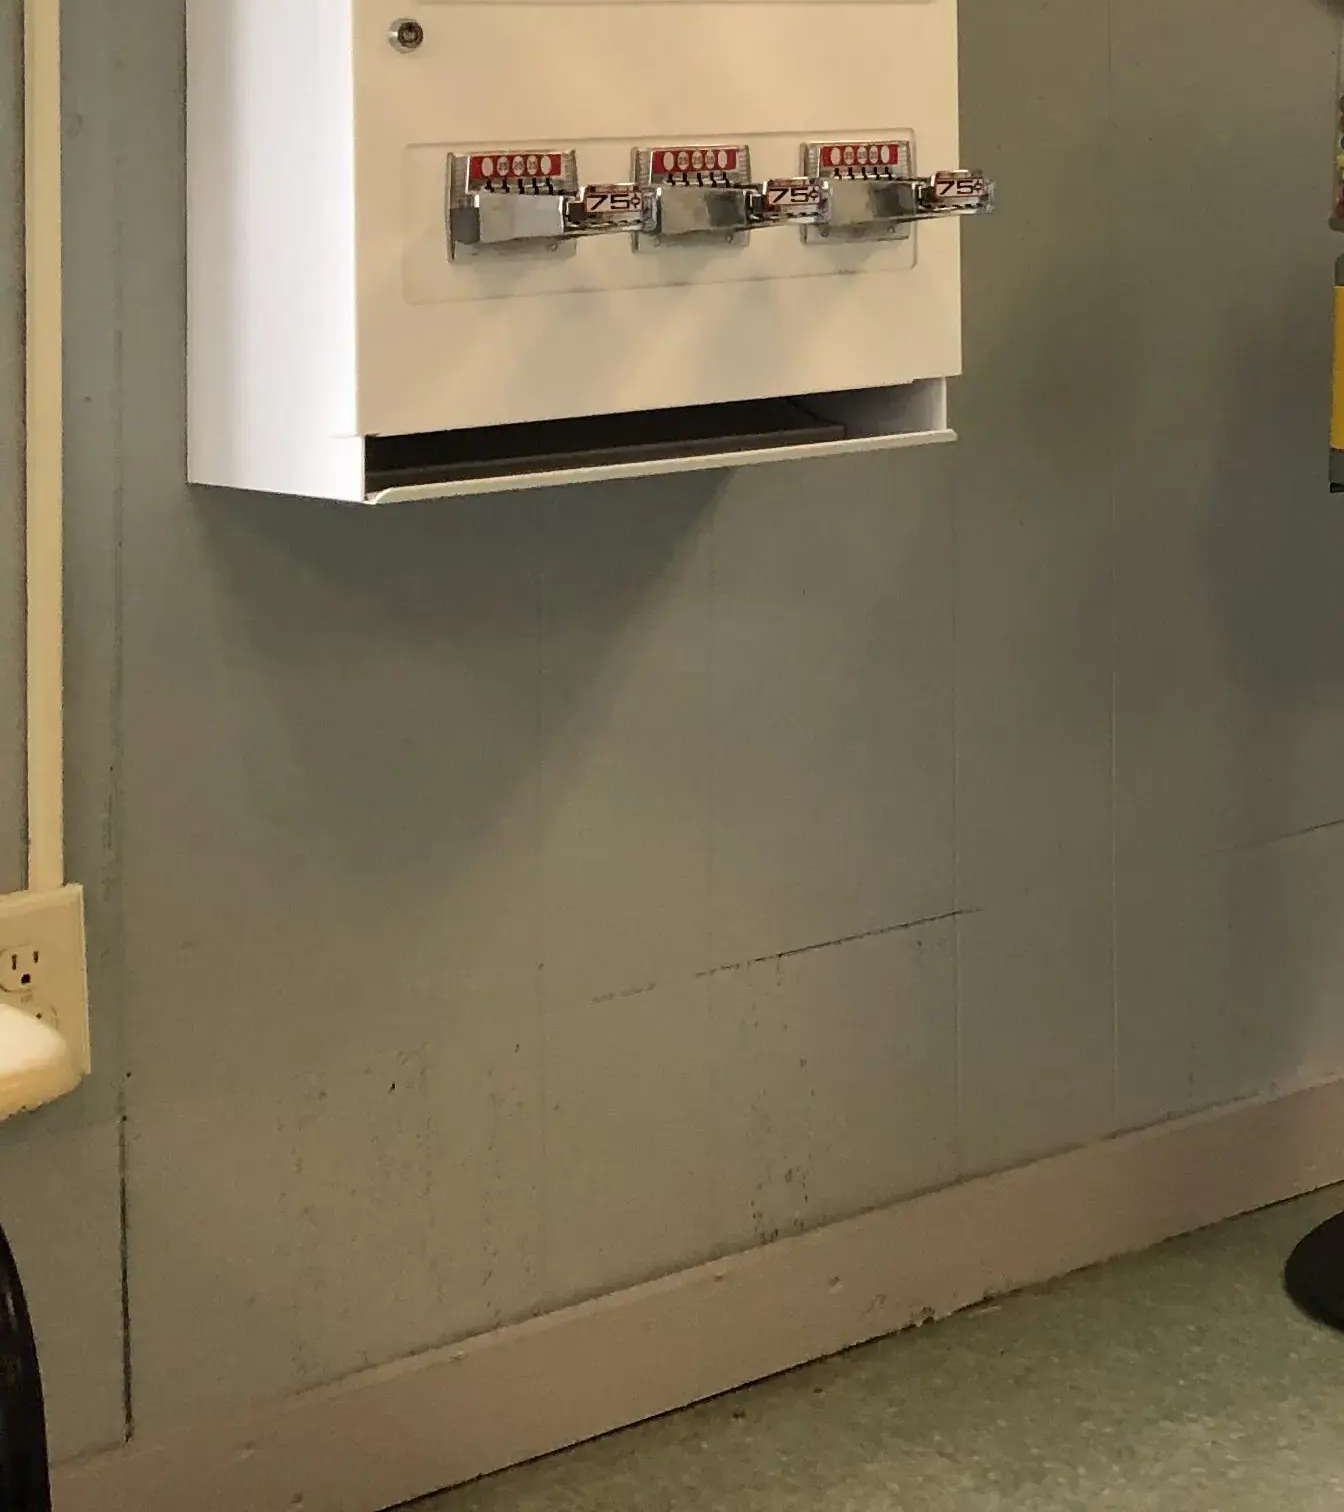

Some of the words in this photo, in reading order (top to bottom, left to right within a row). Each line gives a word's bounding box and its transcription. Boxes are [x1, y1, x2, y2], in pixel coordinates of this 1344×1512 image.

[770, 187, 820, 203] 75¢
[937, 180, 983, 195] 75¢
[588, 193, 641, 211] 75¢
